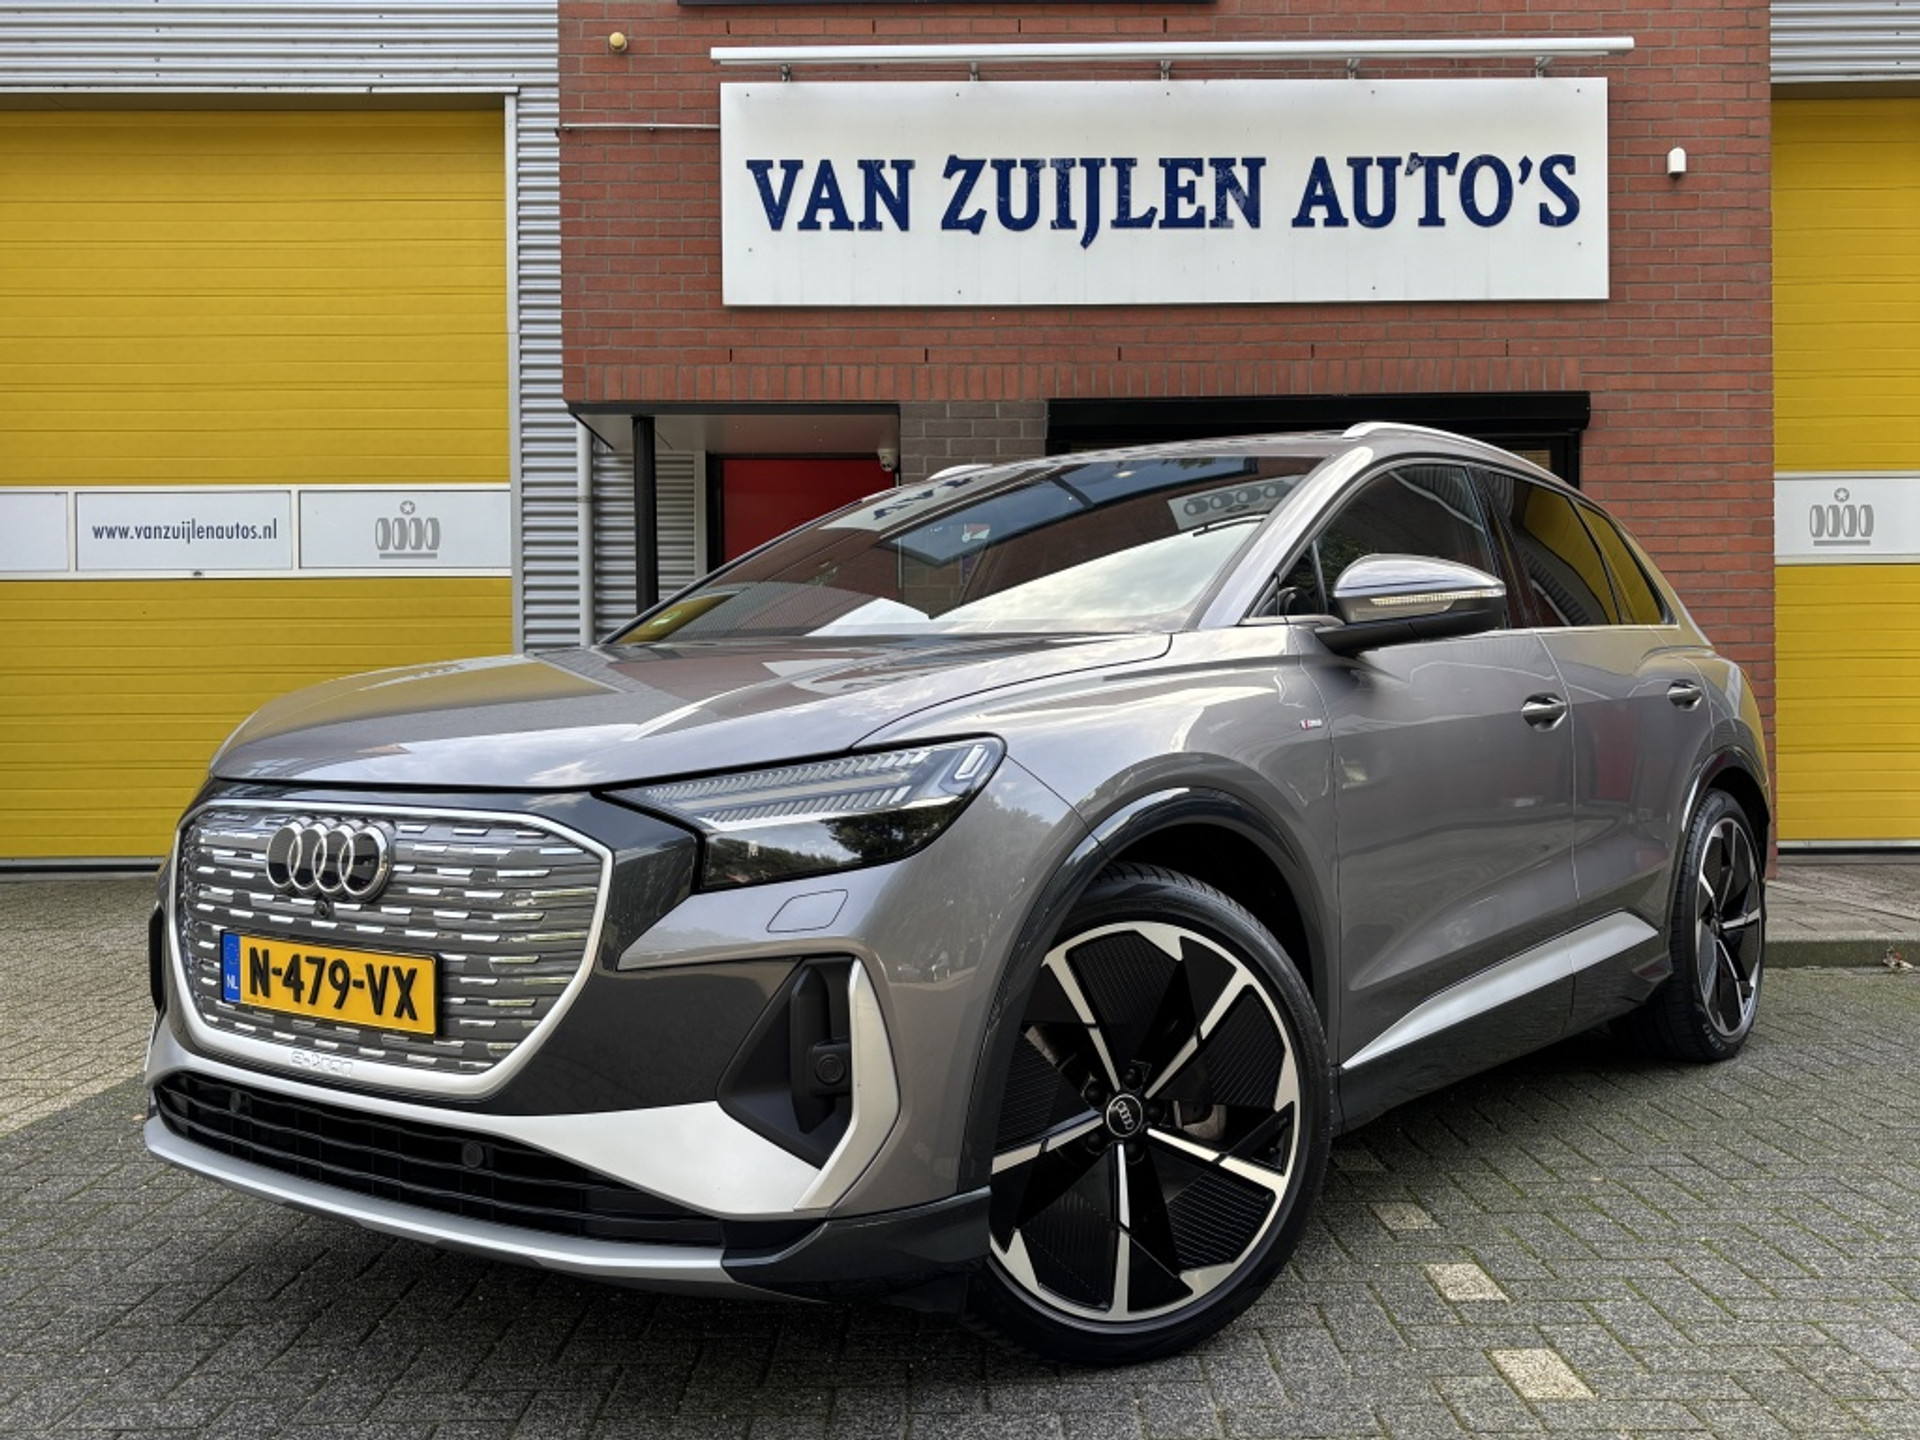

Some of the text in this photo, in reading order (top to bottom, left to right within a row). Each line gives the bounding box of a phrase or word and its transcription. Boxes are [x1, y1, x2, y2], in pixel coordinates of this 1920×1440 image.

[746, 152, 1580, 250] VAN ZUIJLEN AUTO'S
[92, 517, 278, 544] www.vanzuijlenautos.nl
[226, 974, 239, 990] NL
[249, 947, 418, 1021] N-479-VX
